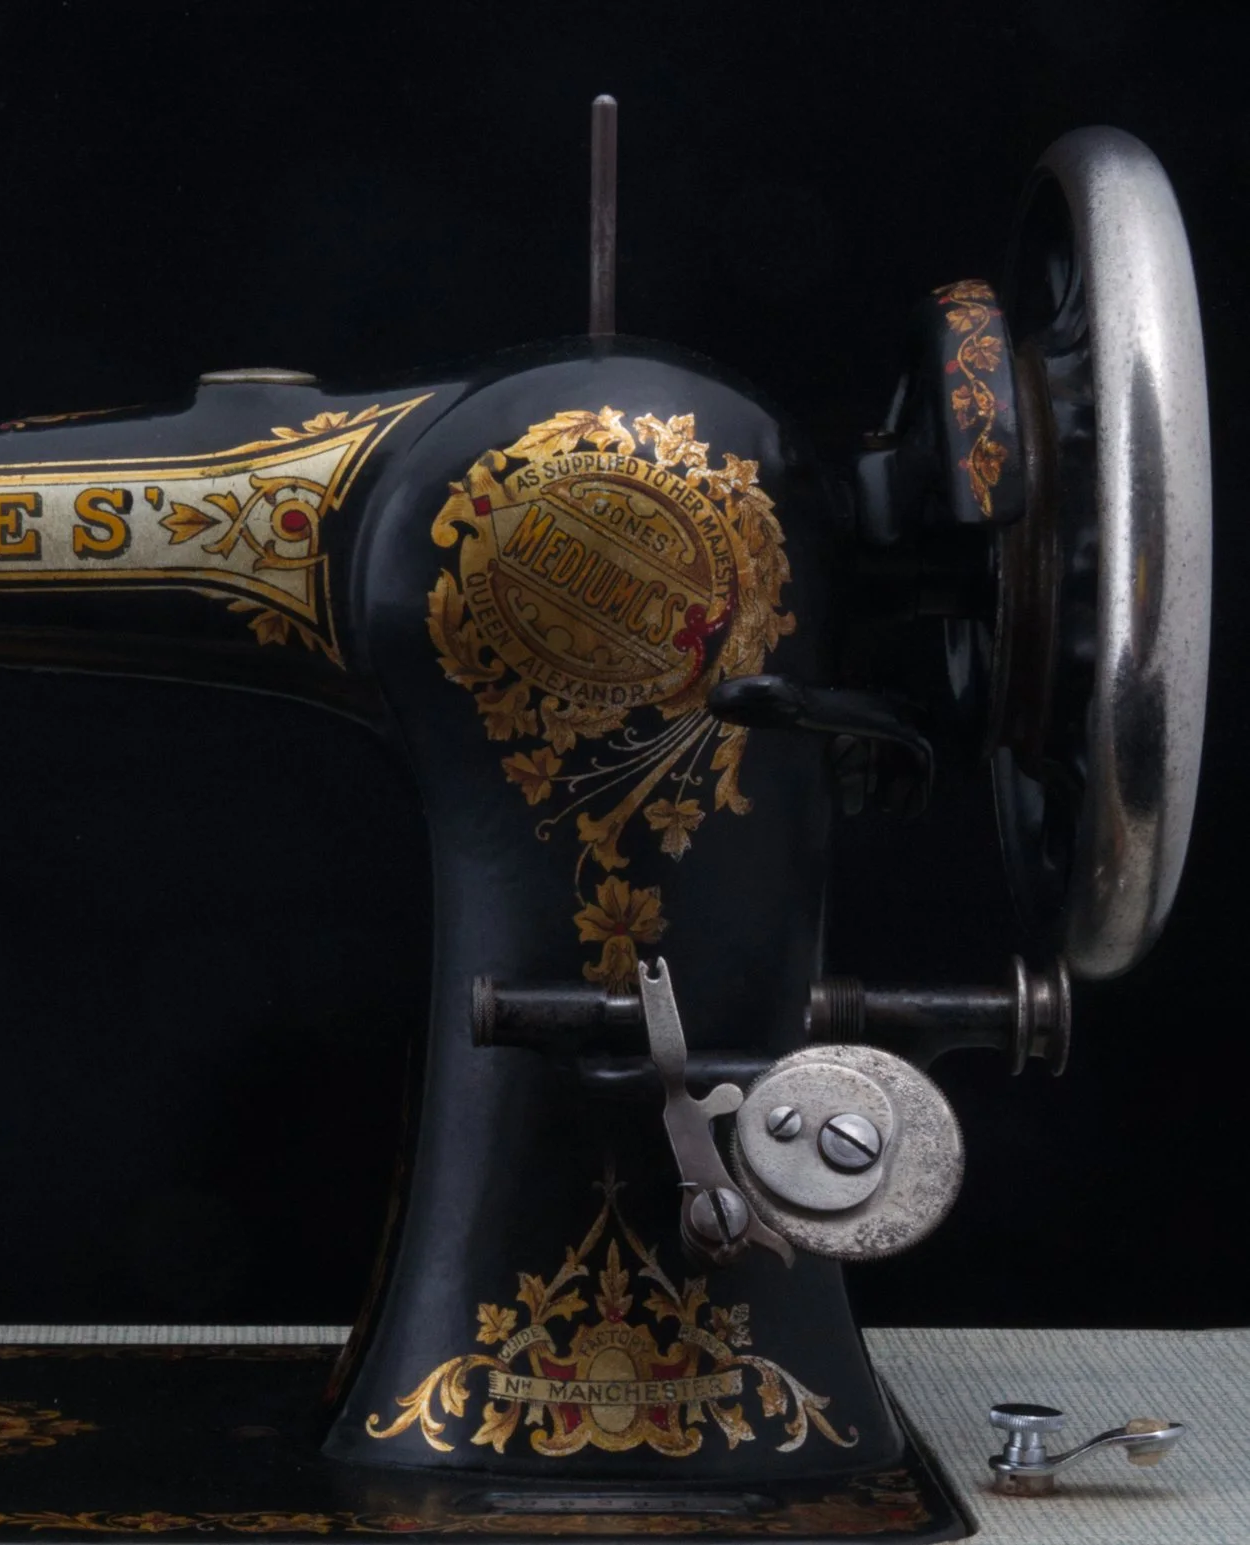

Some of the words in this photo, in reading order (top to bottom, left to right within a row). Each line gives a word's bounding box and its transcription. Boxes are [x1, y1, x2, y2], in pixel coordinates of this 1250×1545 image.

[516, 468, 540, 493] AS
[542, 453, 639, 480] SUPPLIED
[643, 463, 668, 488] TO
[668, 478, 706, 518] HER
[699, 514, 735, 600] MAJESTY
[465, 571, 514, 648] QUEEN
[515, 654, 667, 706] ALEXANDRA
[549, 1376, 724, 1402] MANCHESTER
